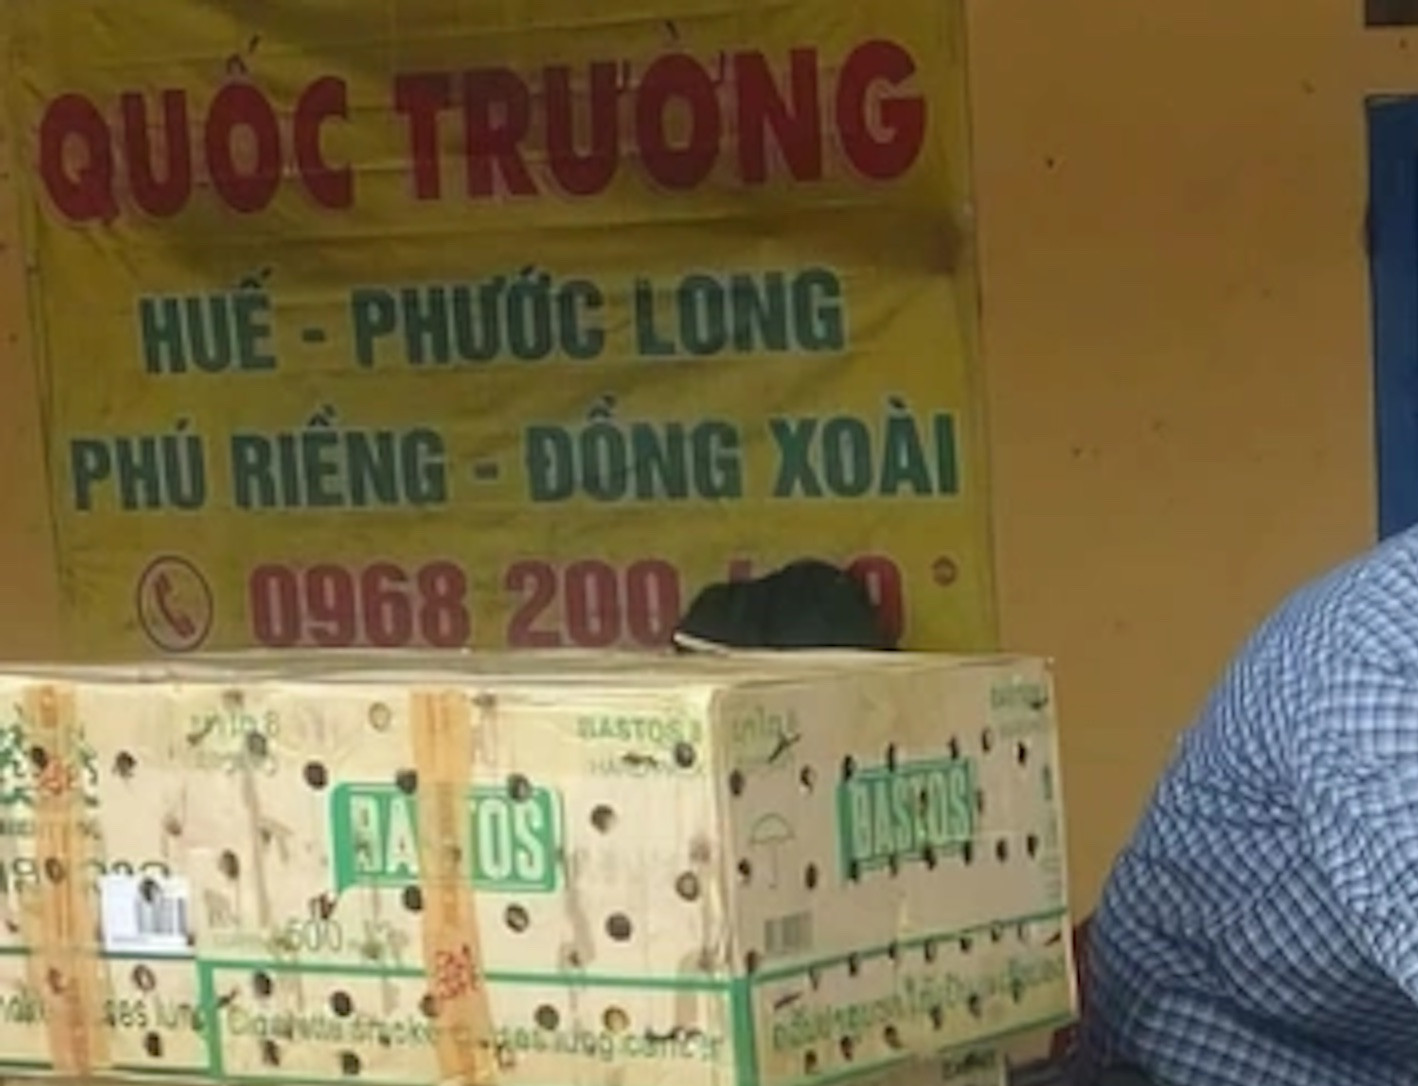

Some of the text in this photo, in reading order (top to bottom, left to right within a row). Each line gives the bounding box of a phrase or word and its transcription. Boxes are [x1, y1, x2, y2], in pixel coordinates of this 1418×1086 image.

[38, 20, 928, 229] QUỐC TRƯỜNG
[141, 267, 277, 374] HUẾ
[352, 264, 606, 368] PHƯỚC
[634, 269, 846, 357] LONG
[70, 418, 206, 512] PHÚ
[231, 404, 447, 509] RIỀNG
[524, 396, 743, 503] ĐỒNG
[770, 399, 958, 498] XOÀI
[248, 563, 471, 648] 0968
[504, 560, 682, 648] 200
